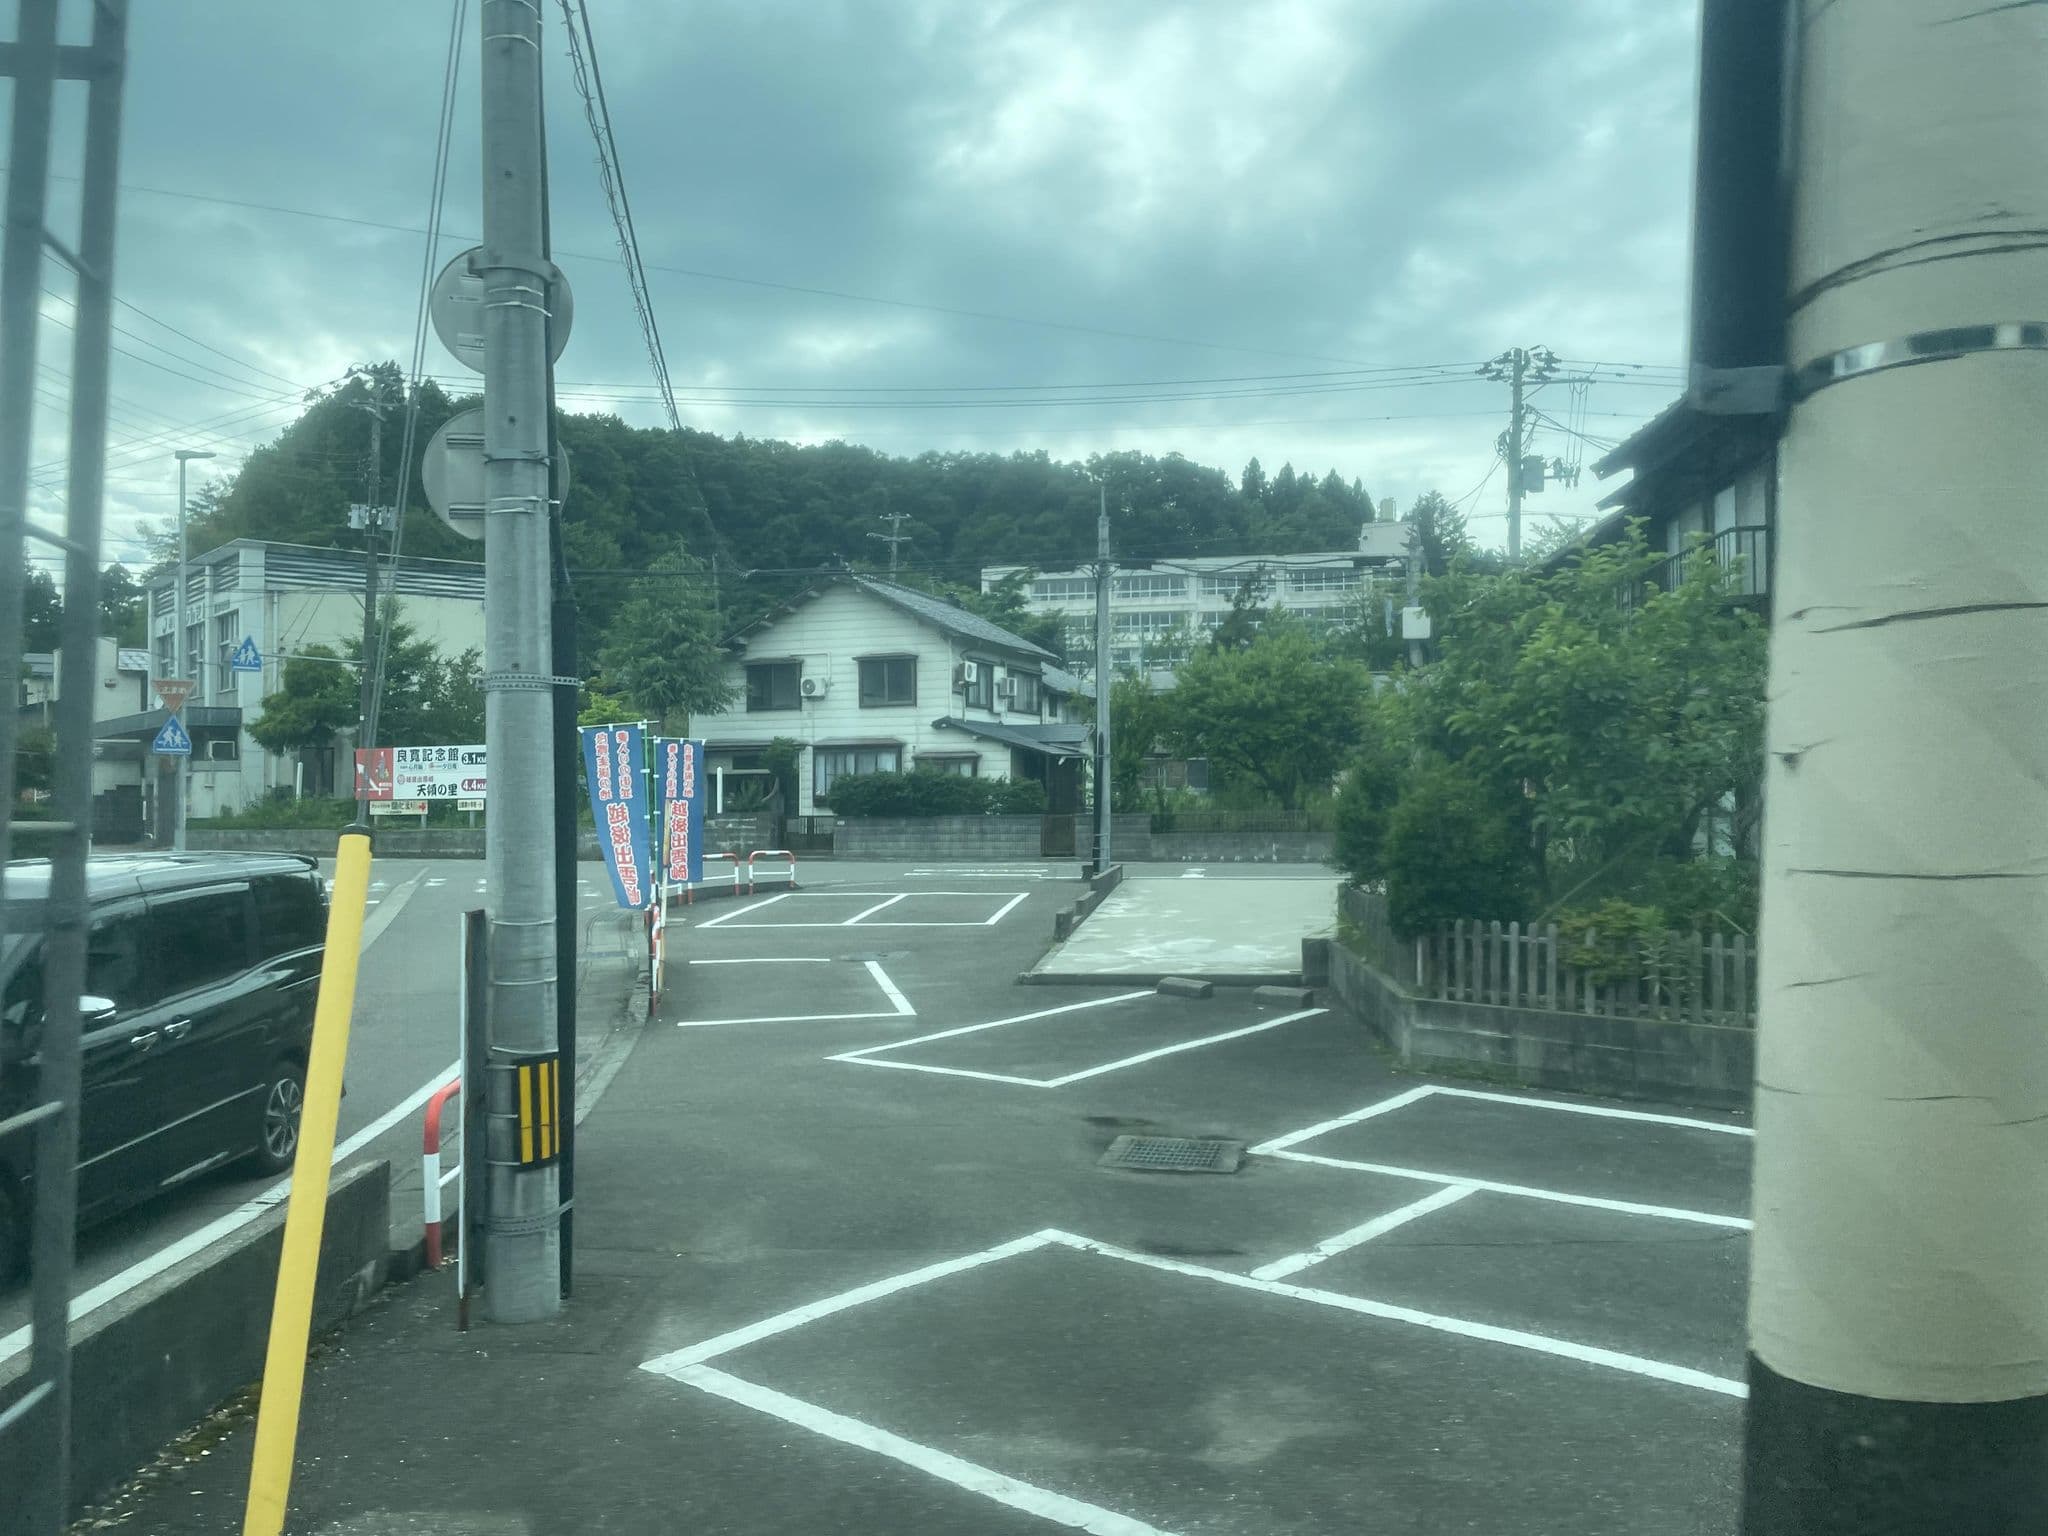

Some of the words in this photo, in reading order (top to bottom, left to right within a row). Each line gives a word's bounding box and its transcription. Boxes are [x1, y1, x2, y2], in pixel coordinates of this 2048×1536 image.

[397, 748, 459, 762] 良寛記念館
[417, 784, 457, 796] 天領の里
[670, 800, 689, 880] 越後出雲崎
